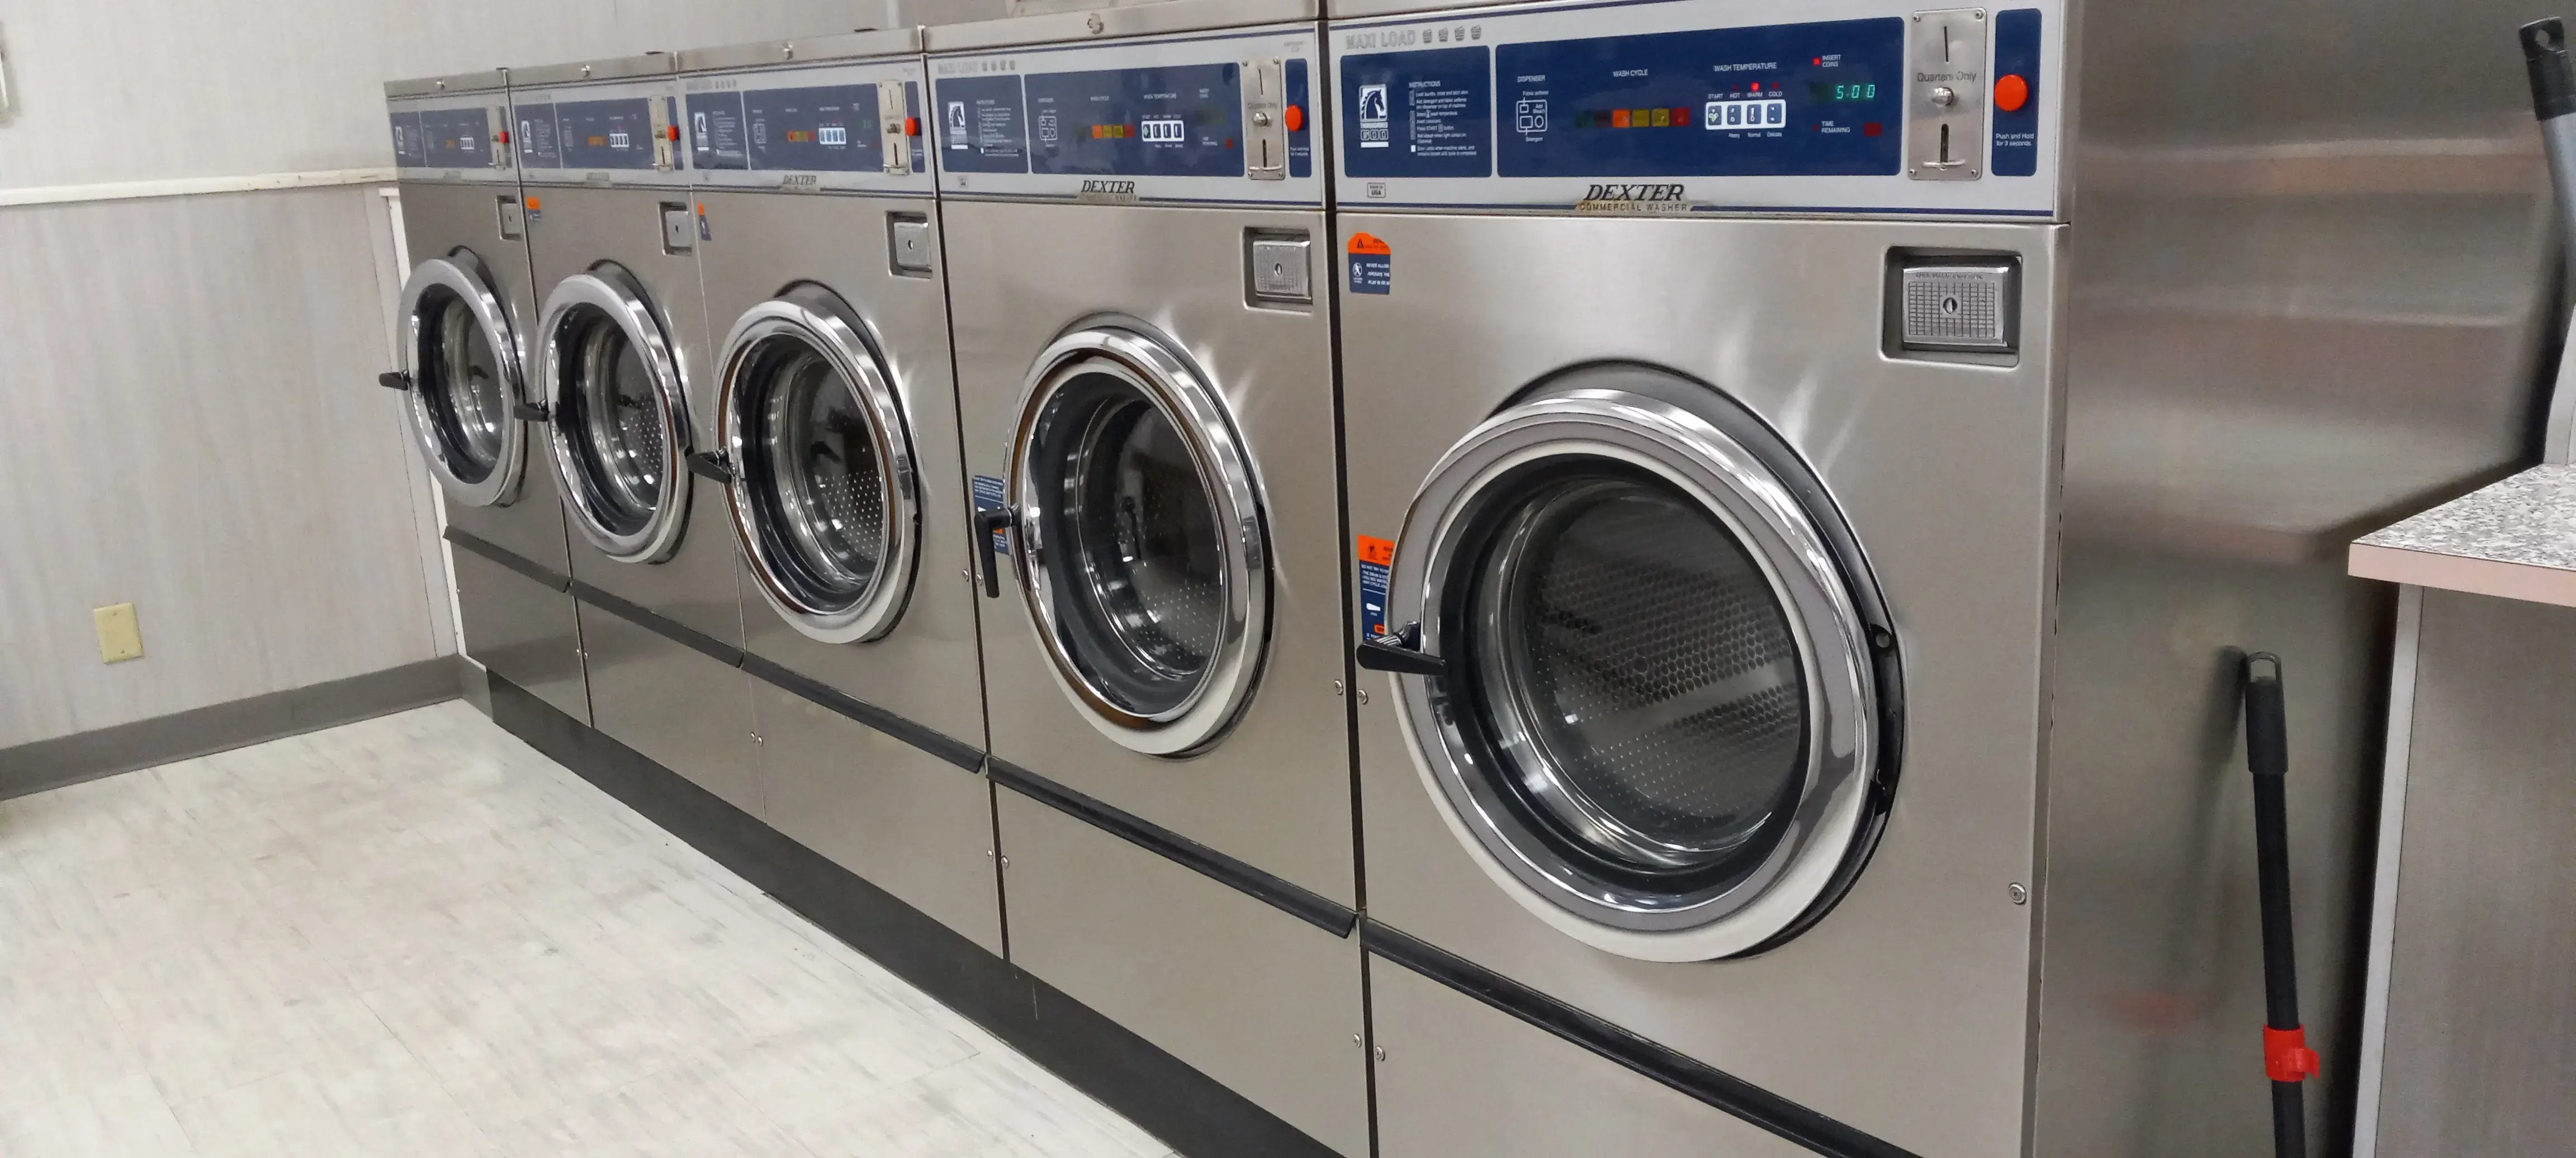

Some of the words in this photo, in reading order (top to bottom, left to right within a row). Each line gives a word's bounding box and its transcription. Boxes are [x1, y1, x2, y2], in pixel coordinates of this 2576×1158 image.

[1346, 34, 1376, 49] MAXI
[1381, 30, 1415, 47] LOAD
[1733, 62, 1777, 71] TEMPERATURE
[1917, 73, 1953, 82] Quarters
[1957, 71, 1977, 83] Only
[1080, 180, 1135, 193] DEXTER
[1583, 184, 1684, 201] DEXTER
[1580, 203, 1642, 211] COMMERCIAL
